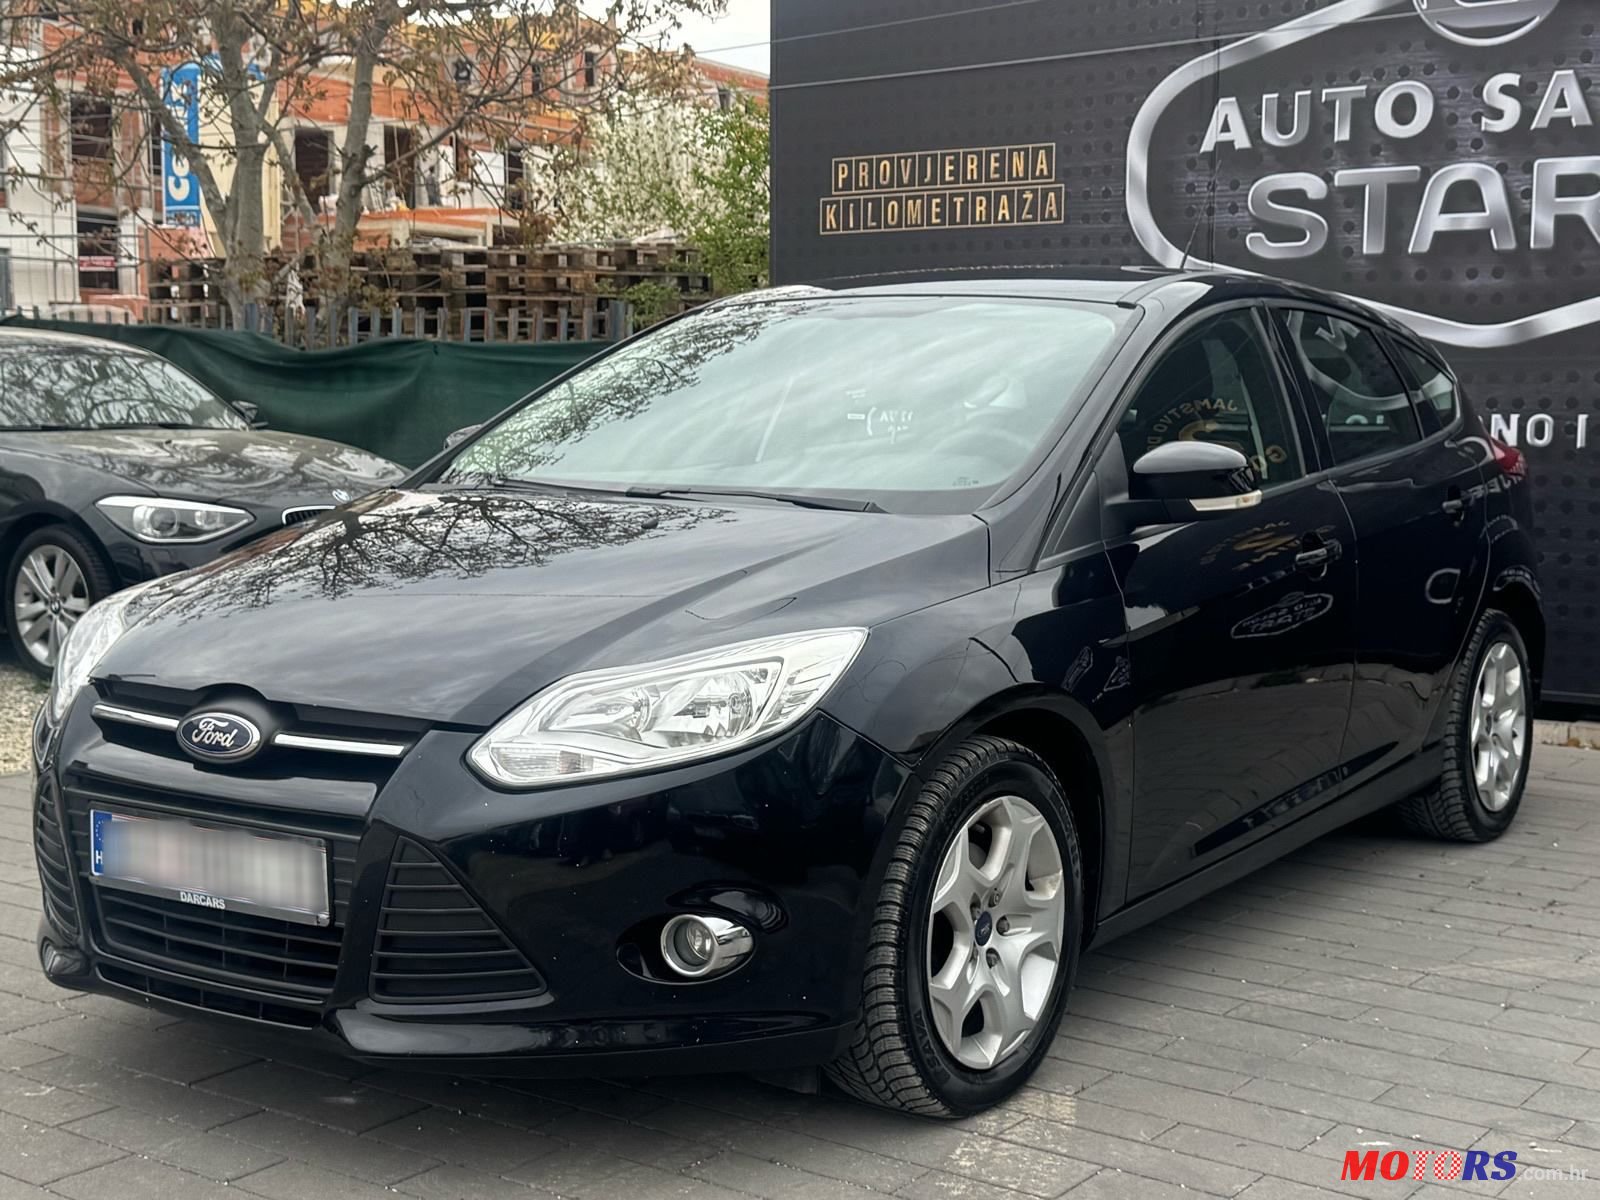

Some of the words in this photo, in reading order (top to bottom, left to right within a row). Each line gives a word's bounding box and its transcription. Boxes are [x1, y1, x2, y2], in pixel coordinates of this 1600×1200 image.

[1200, 79, 1435, 154] AUTO
[1481, 68, 1593, 132] SA
[837, 149, 1049, 188] PROVJERENA
[825, 191, 1058, 229] KILOMETRAŽA
[1245, 155, 1600, 260] STAR
[191, 717, 239, 748] Ford
[180, 891, 226, 910] DARCARS
